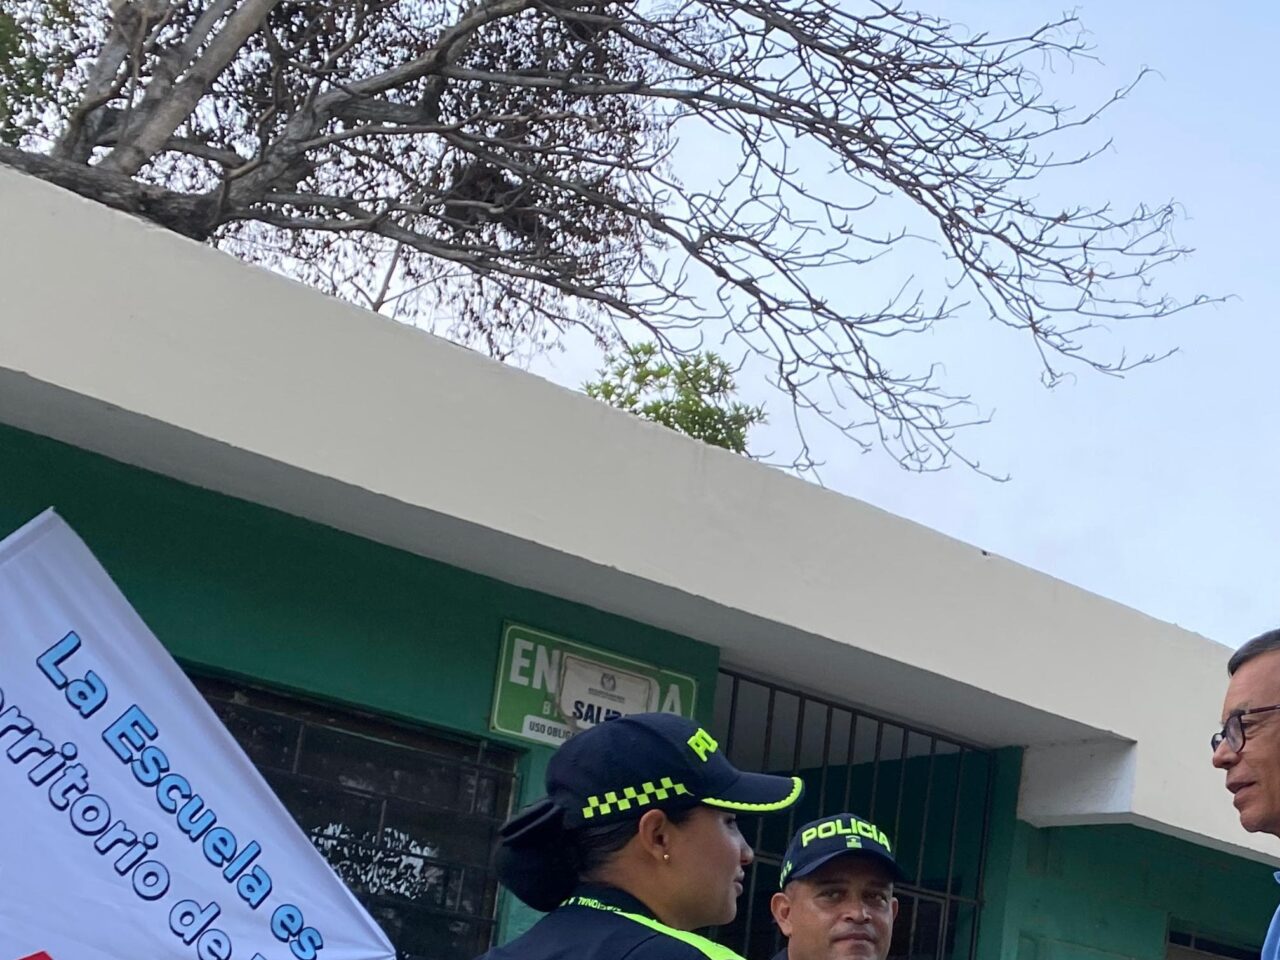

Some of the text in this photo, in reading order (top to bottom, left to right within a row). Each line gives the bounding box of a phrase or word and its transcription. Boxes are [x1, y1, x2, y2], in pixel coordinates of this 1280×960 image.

[0, 687, 170, 901] rritorio
[36, 630, 107, 718] La
[102, 704, 272, 910] Escuela
[529, 721, 546, 734] USO
